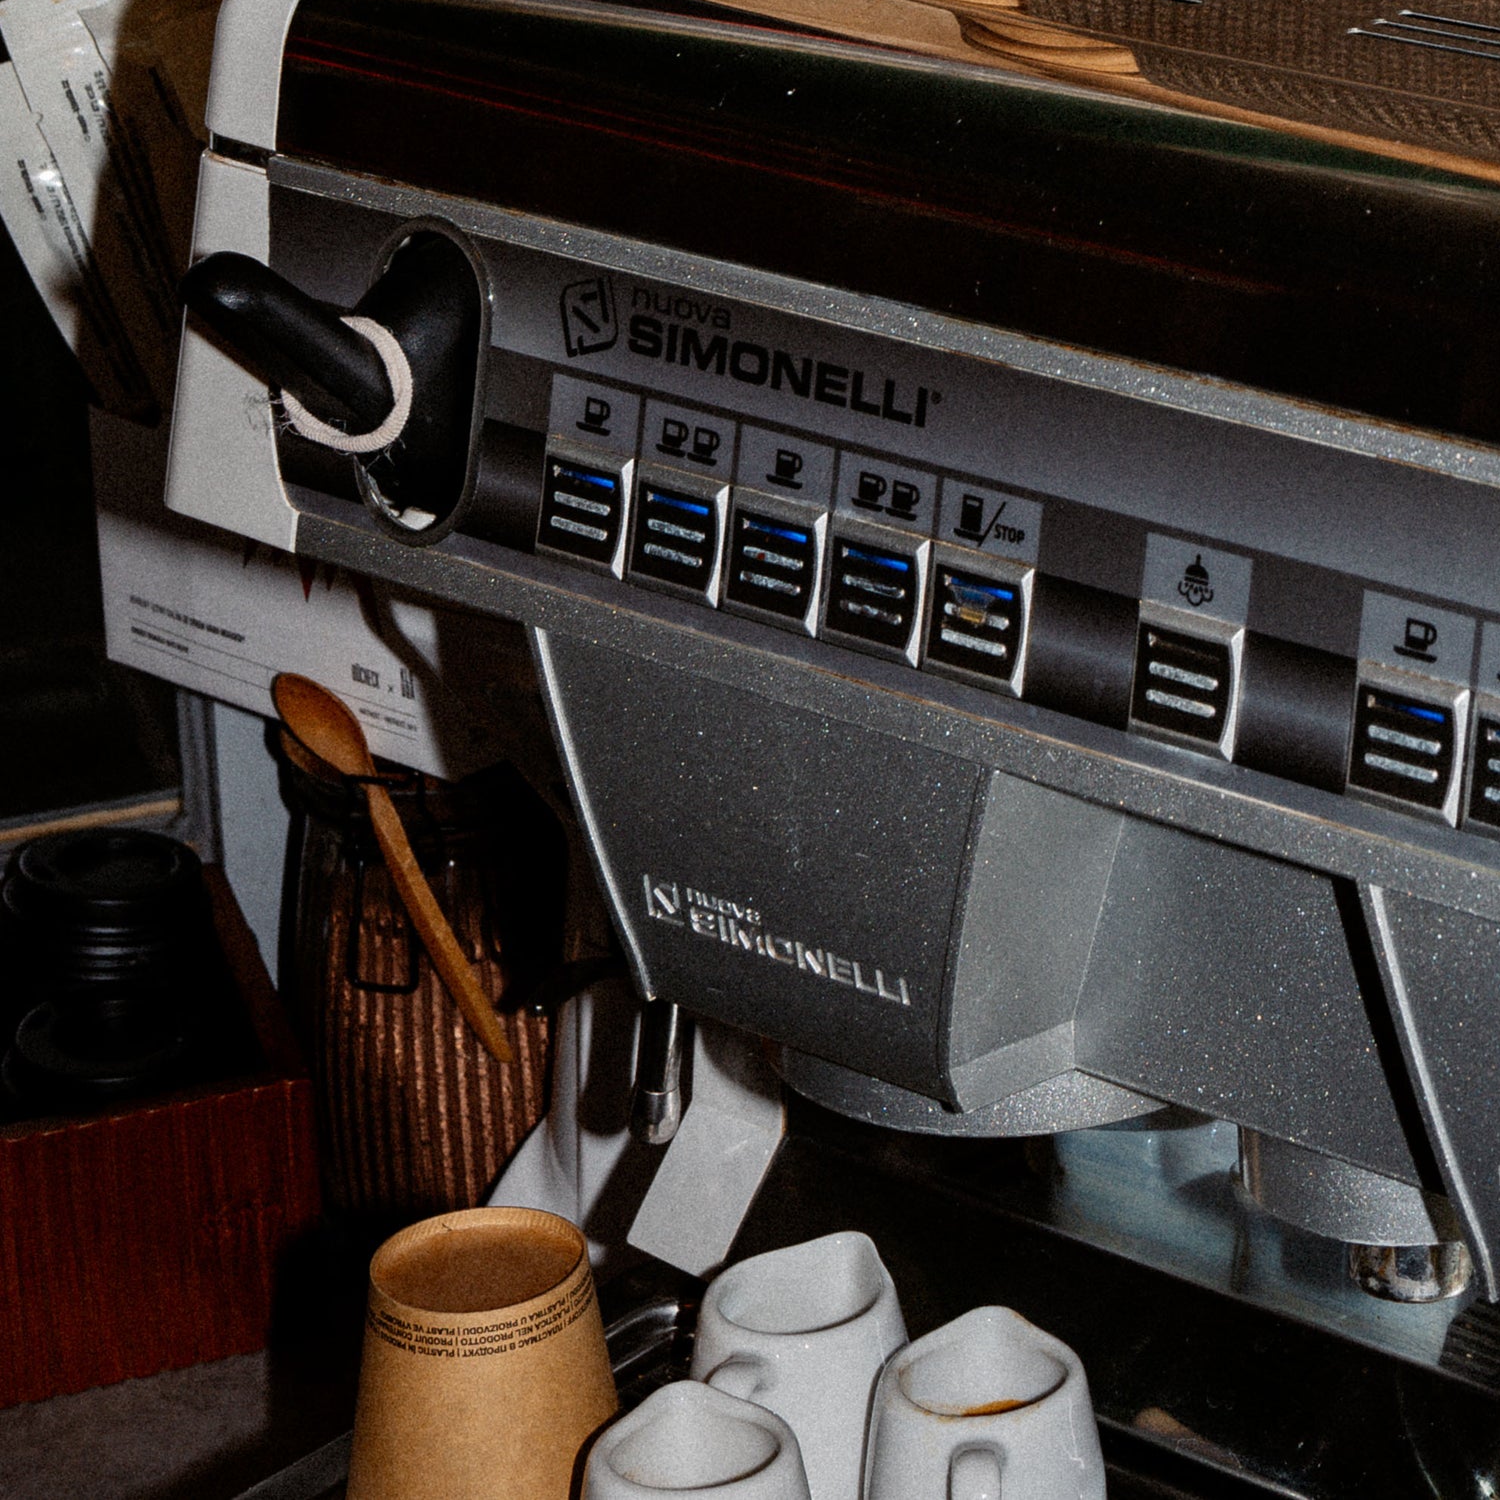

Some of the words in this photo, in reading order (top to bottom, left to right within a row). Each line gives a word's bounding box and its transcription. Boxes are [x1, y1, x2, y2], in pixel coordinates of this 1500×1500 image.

[630, 284, 732, 330] nuova
[993, 521, 1026, 546] STOP
[687, 887, 761, 924] nuova
[689, 909, 911, 1006] SIMONELLI
[528, 1298, 565, 1321] PLASTIKA
[535, 1305, 570, 1331] PLASTICA
[412, 1324, 424, 1332] VE
[427, 1327, 455, 1335] PLAST
[462, 1320, 518, 1335] PROIZVODU
[515, 1325, 533, 1337] NEL
[414, 1335, 453, 1346] PRODUIT
[460, 1331, 514, 1346] PRODOTTO
[418, 1346, 455, 1357] PLASTIC
[462, 1344, 506, 1358] ПРОДУКТ
